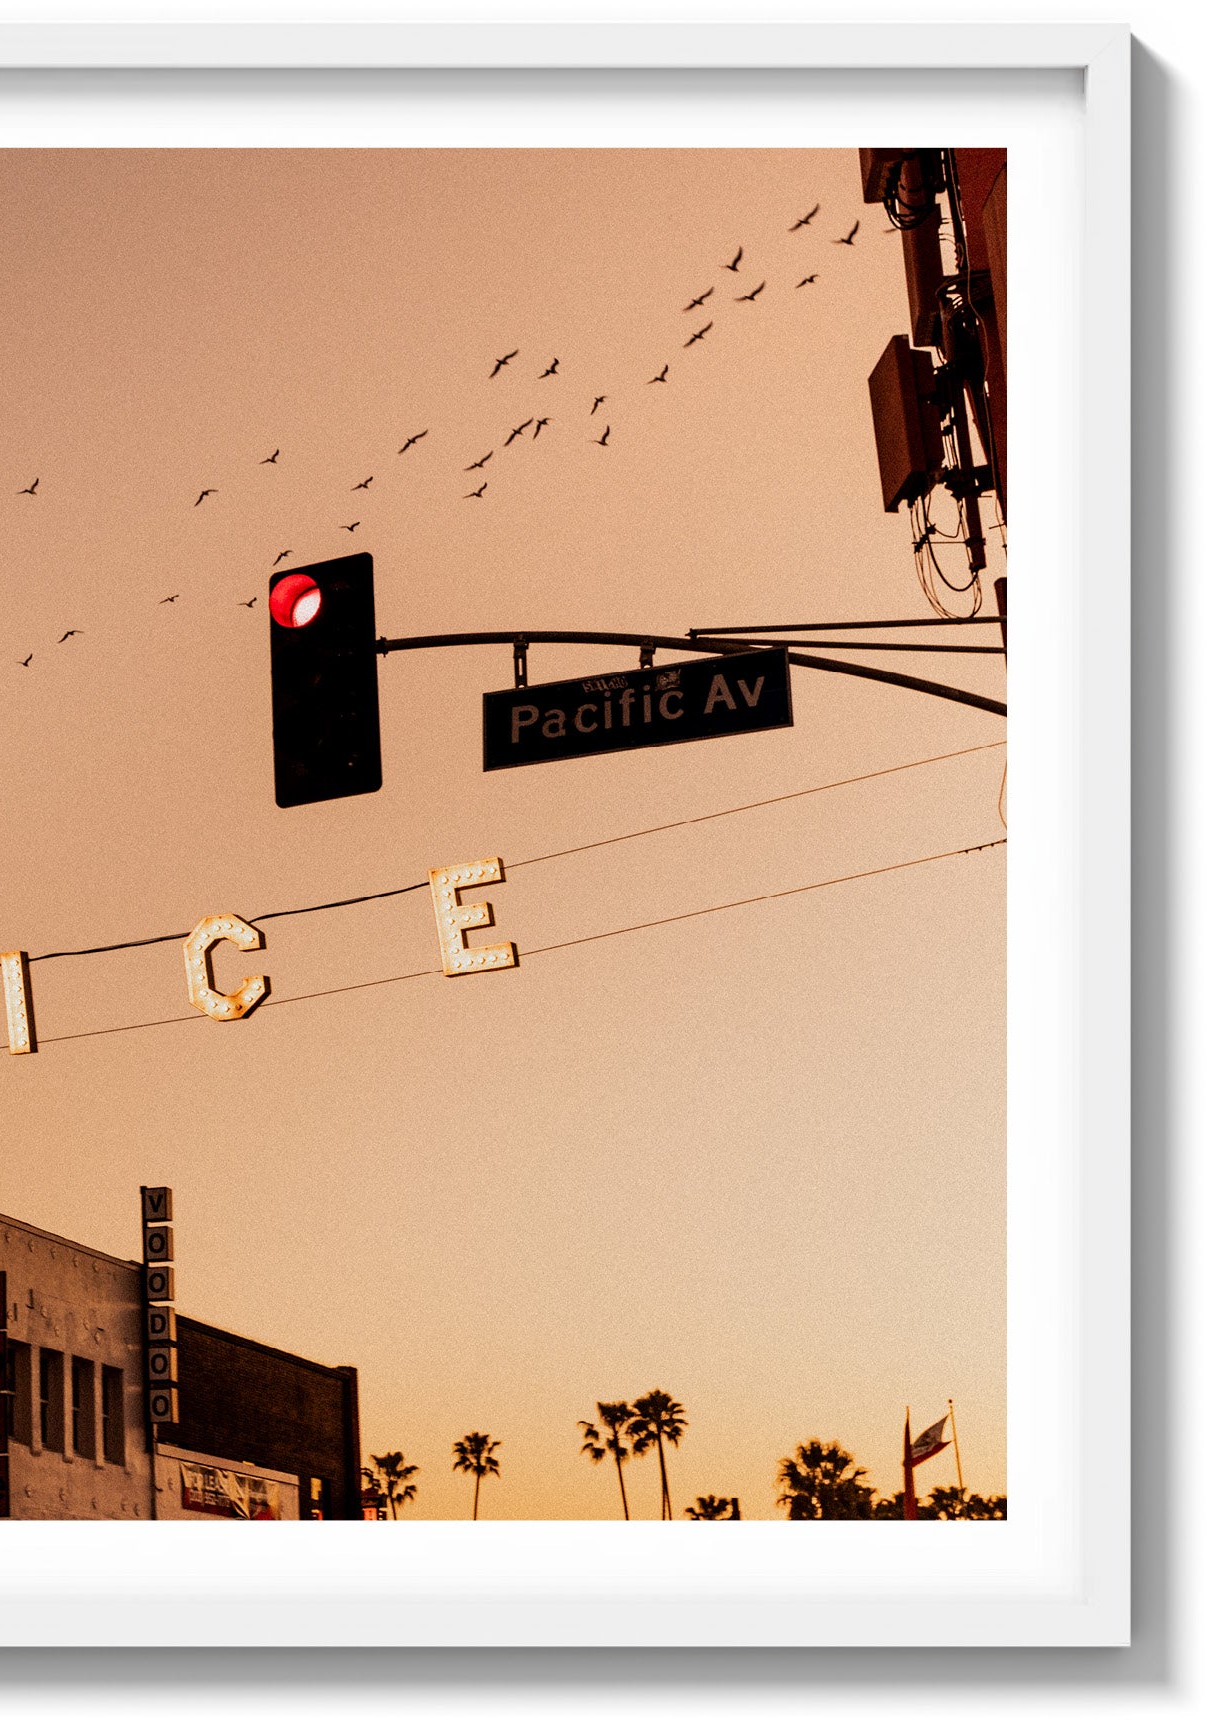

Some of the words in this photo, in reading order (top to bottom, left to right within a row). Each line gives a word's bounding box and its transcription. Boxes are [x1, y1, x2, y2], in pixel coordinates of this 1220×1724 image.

[509, 684, 685, 745] Pacific
[701, 673, 766, 715] Av
[147, 1193, 170, 1418] VOODOO
